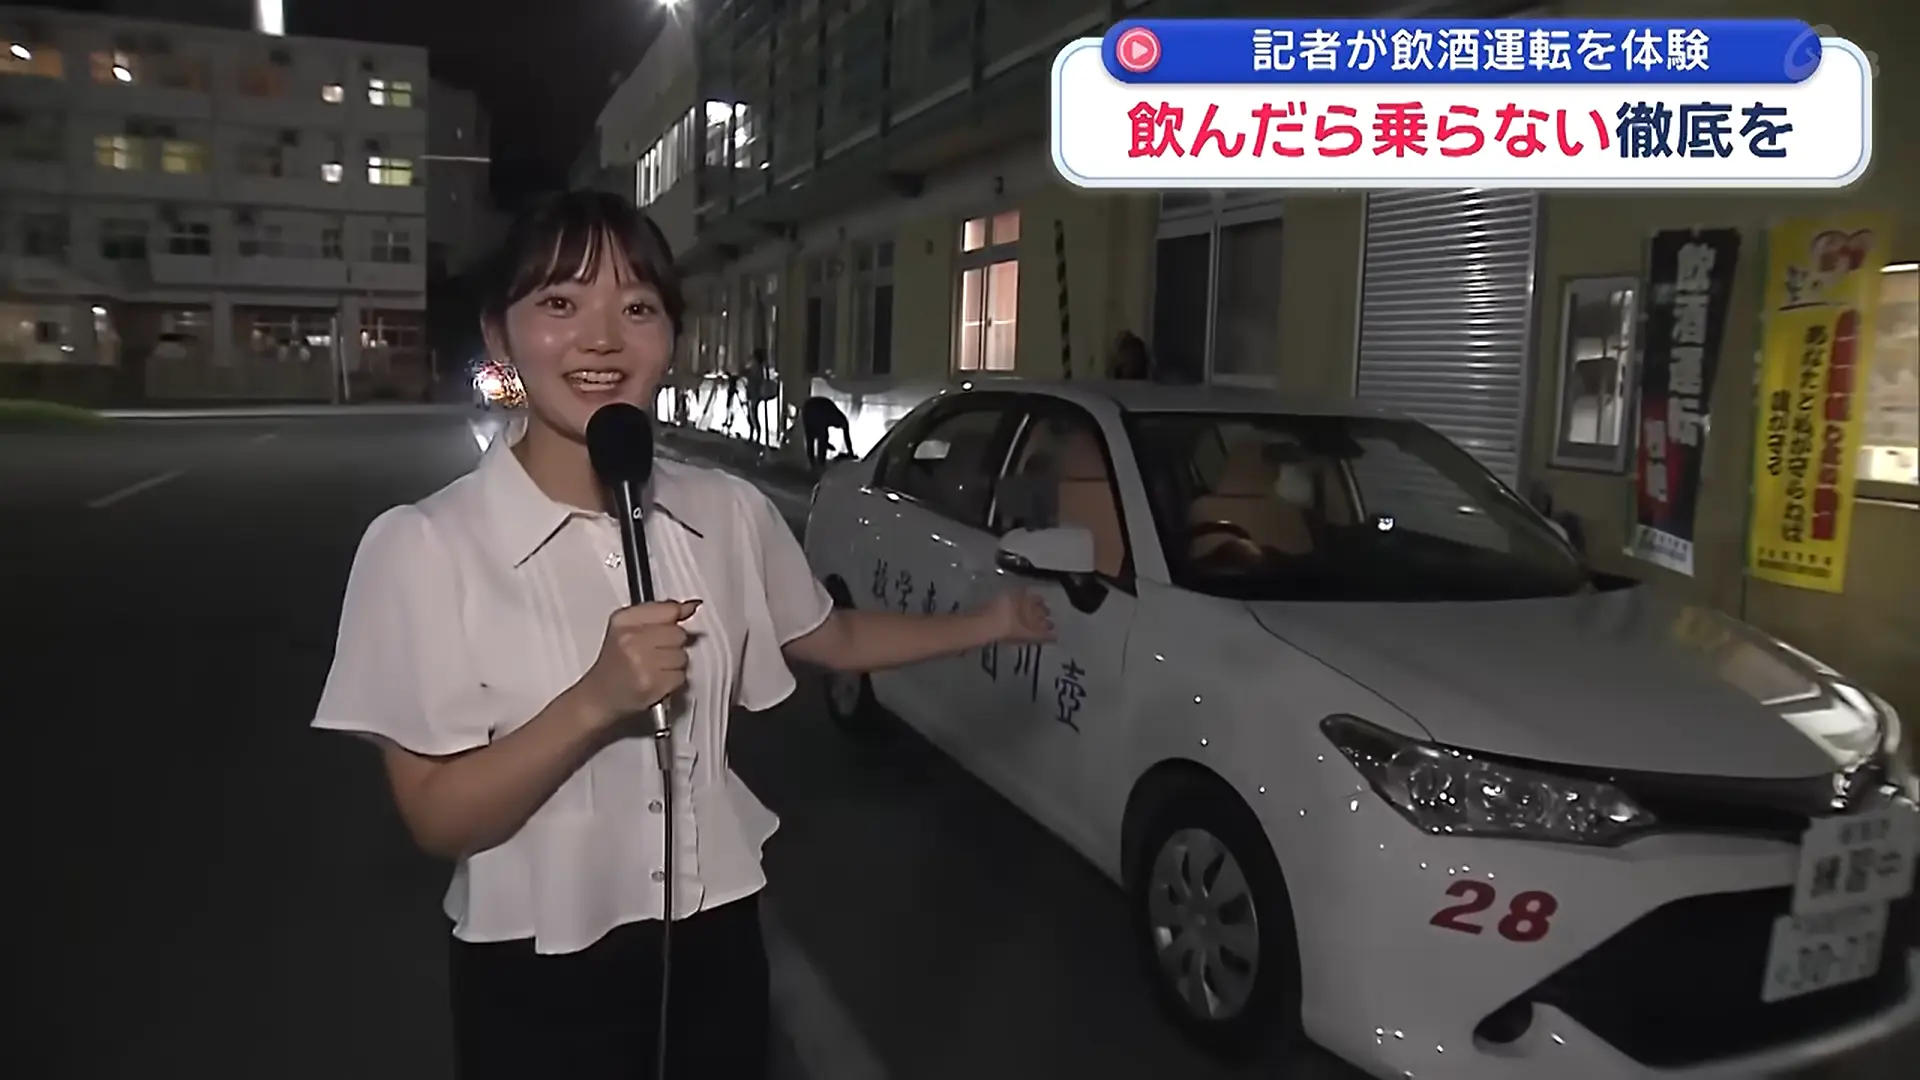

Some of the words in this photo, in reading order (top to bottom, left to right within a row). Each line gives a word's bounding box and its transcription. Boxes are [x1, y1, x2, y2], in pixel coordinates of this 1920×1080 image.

[1668, 243, 1716, 446] 飲酒運転
[1429, 879, 1558, 942] 28
